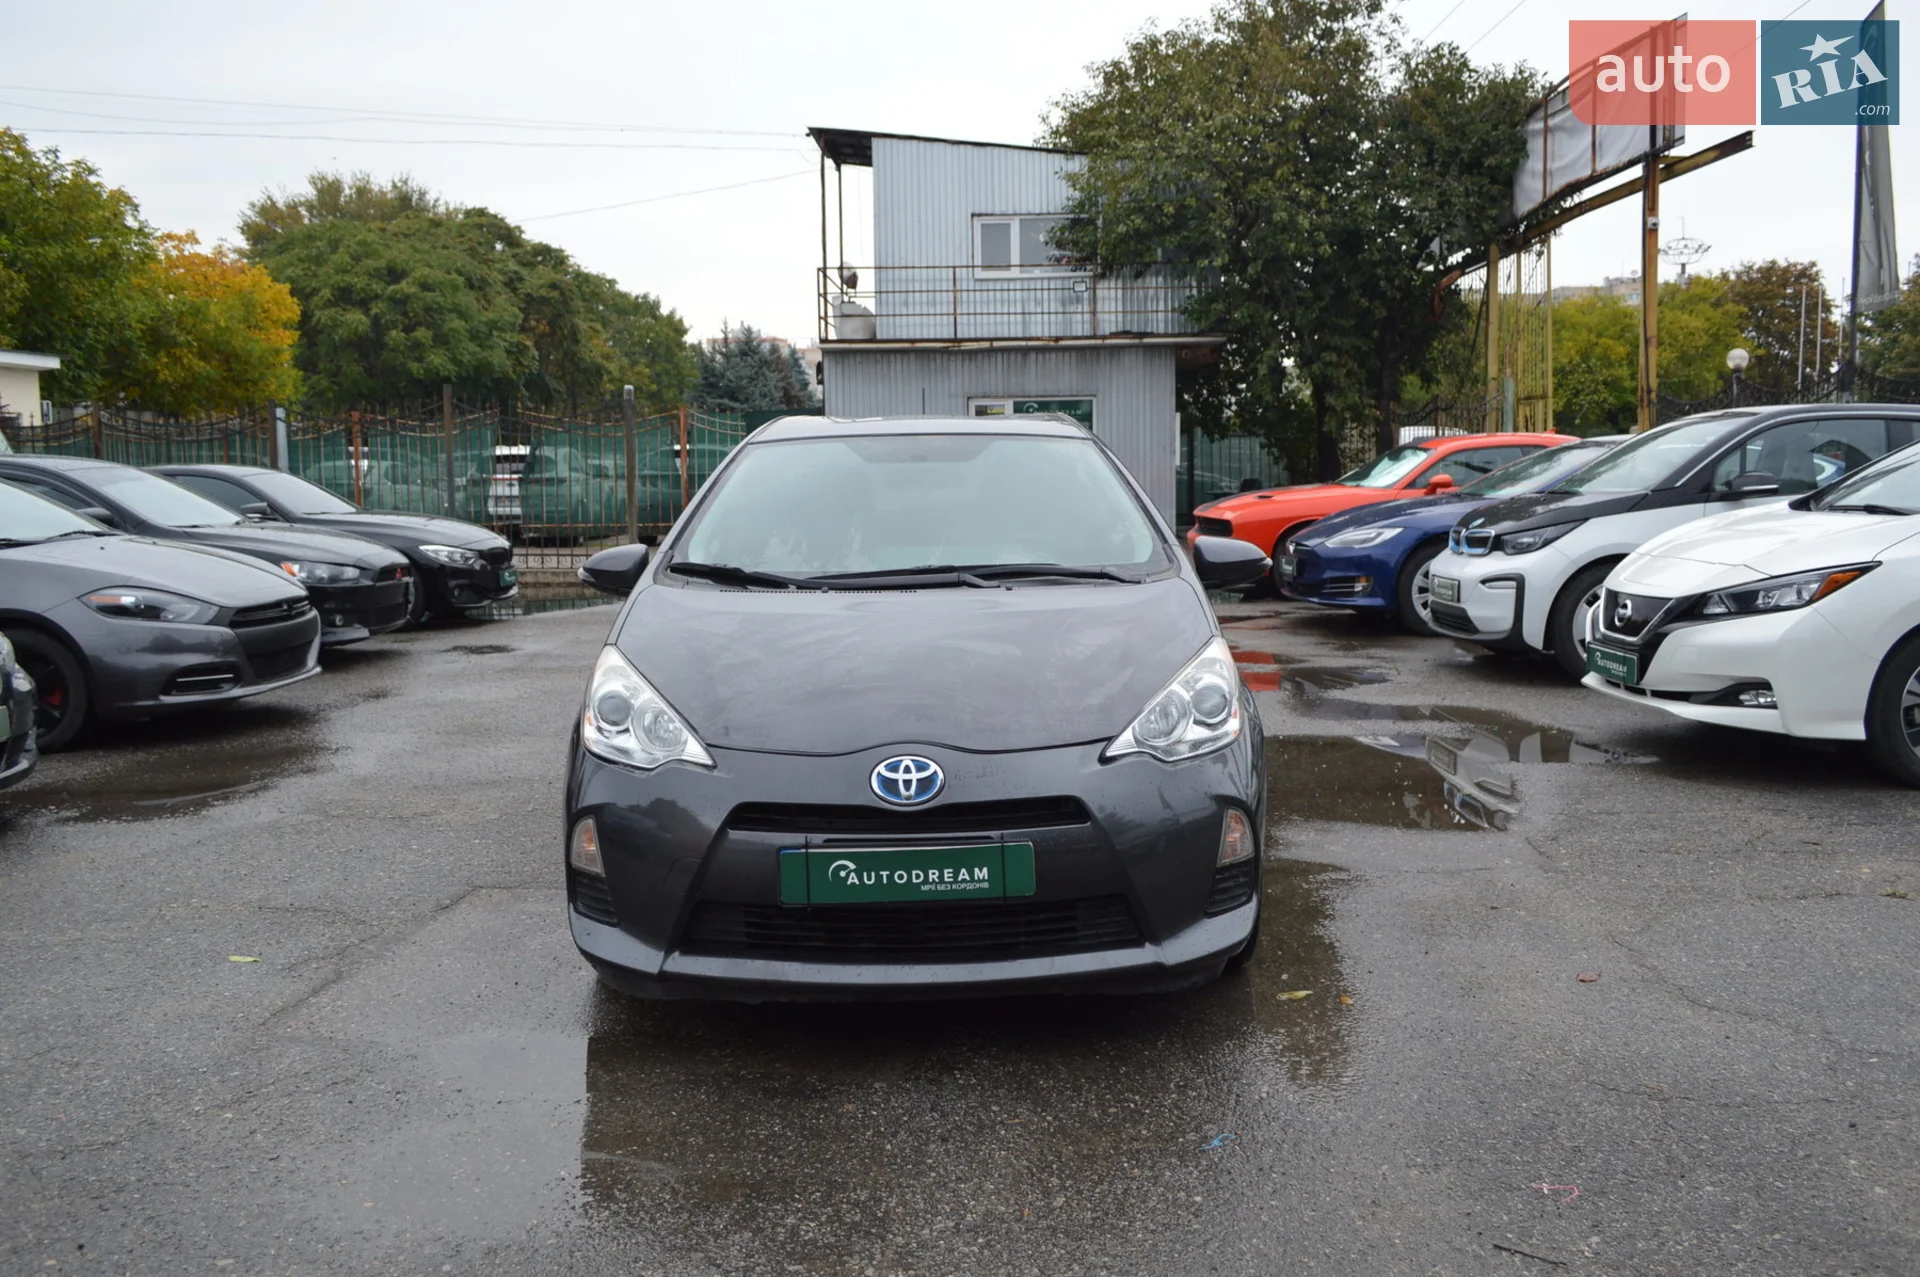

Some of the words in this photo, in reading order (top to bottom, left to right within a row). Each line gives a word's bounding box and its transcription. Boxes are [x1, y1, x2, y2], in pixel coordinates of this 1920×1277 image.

[847, 867, 988, 885] AUTODREAM
[937, 883, 951, 891] БЕЗ
[951, 881, 990, 890] КОРДОНІВ
